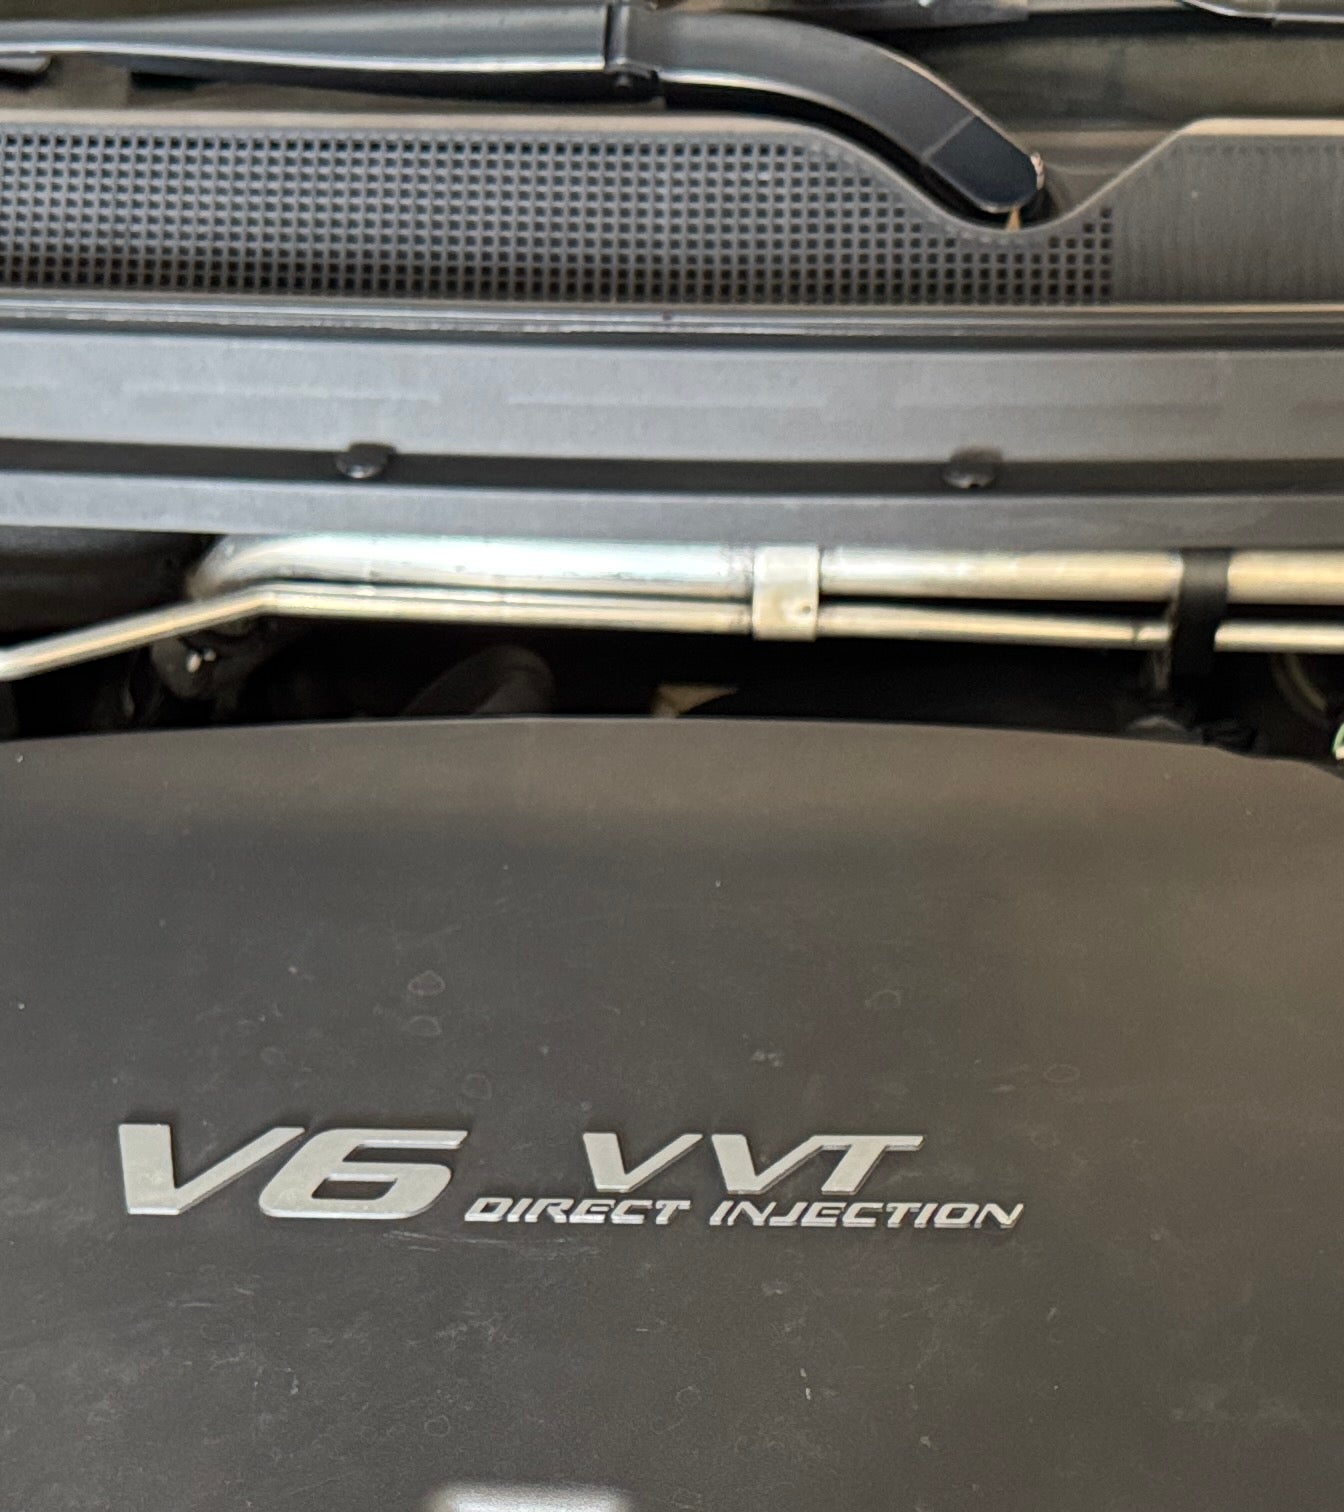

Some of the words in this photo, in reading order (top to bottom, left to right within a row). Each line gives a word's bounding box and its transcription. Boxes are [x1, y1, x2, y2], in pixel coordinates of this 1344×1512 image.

[119, 1123, 467, 1218] V6
[582, 1133, 924, 1195] VVT
[464, 1196, 690, 1226] DIRECT
[709, 1198, 1025, 1230] INJECTION
